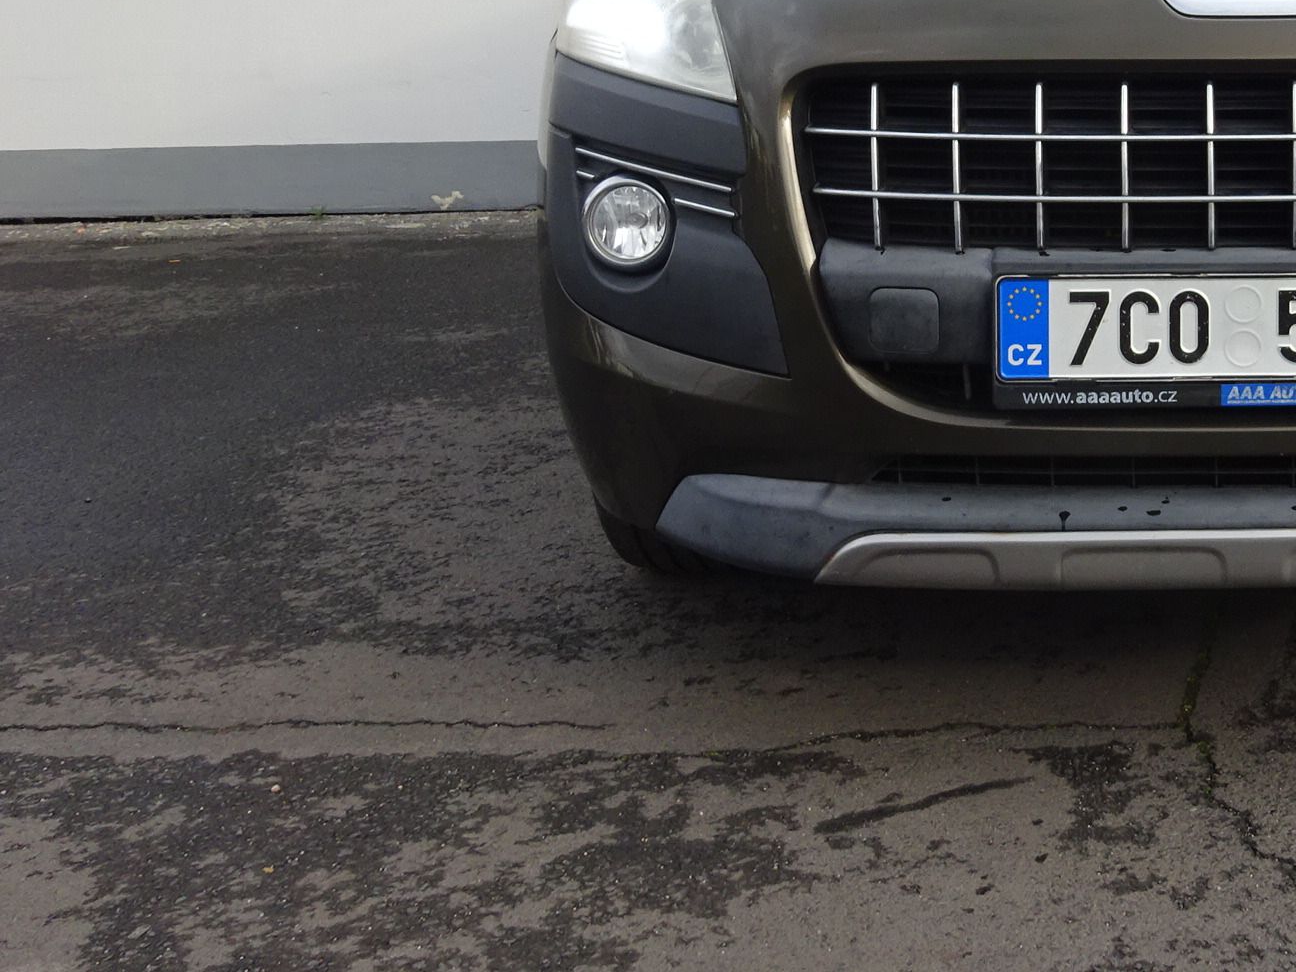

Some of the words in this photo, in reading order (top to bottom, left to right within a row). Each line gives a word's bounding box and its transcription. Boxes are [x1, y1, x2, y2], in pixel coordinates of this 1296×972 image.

[1068, 288, 1210, 367] 7C0
[1007, 343, 1043, 366] CZ
[1022, 389, 1178, 405] www.aaaauto.cz
[1227, 385, 1265, 400] AAA
